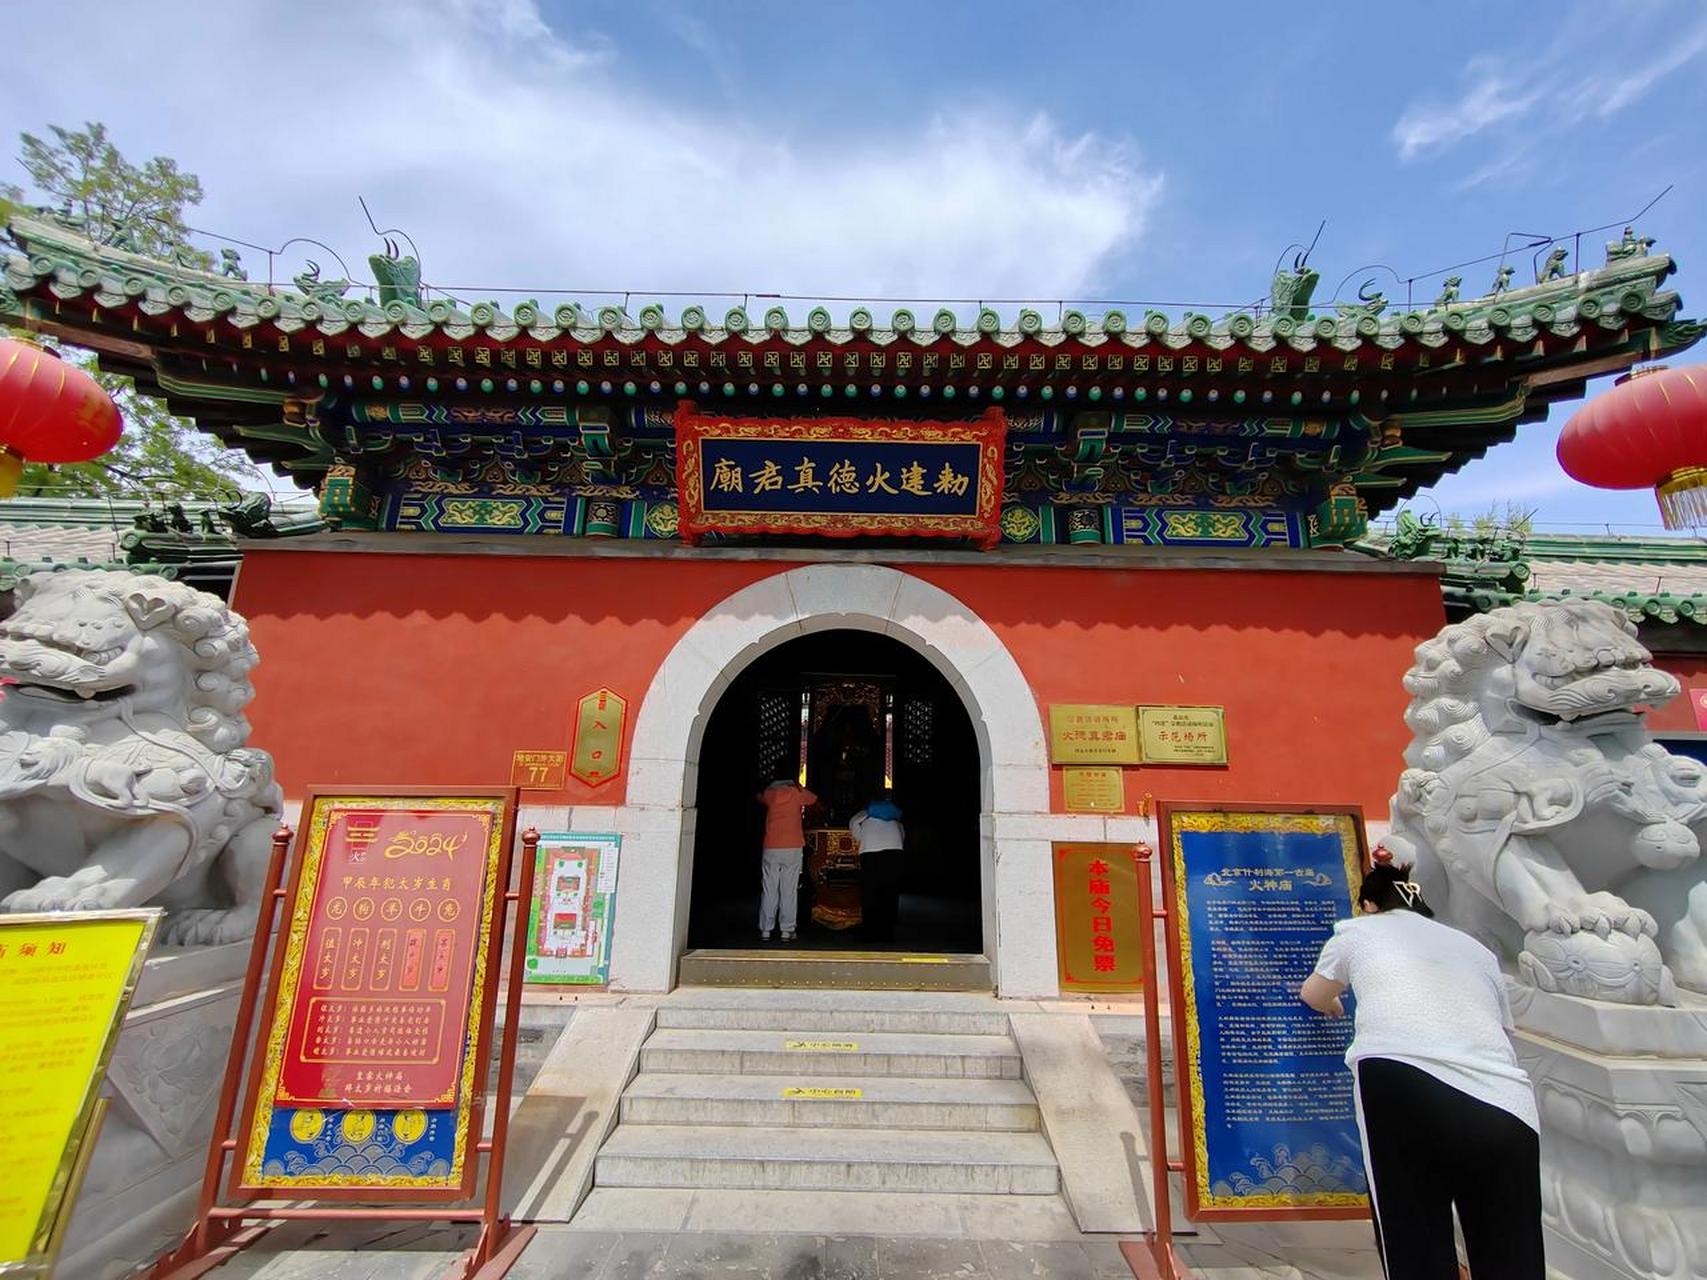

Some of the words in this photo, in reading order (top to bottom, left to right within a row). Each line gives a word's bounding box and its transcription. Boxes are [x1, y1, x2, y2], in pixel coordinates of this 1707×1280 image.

[591, 720, 608, 760] 入口
[528, 767, 549, 782] 77
[384, 830, 468, 861] 2024
[1249, 879, 1292, 891] 火神庙
[1088, 860, 1116, 972] 本庙今日免票
